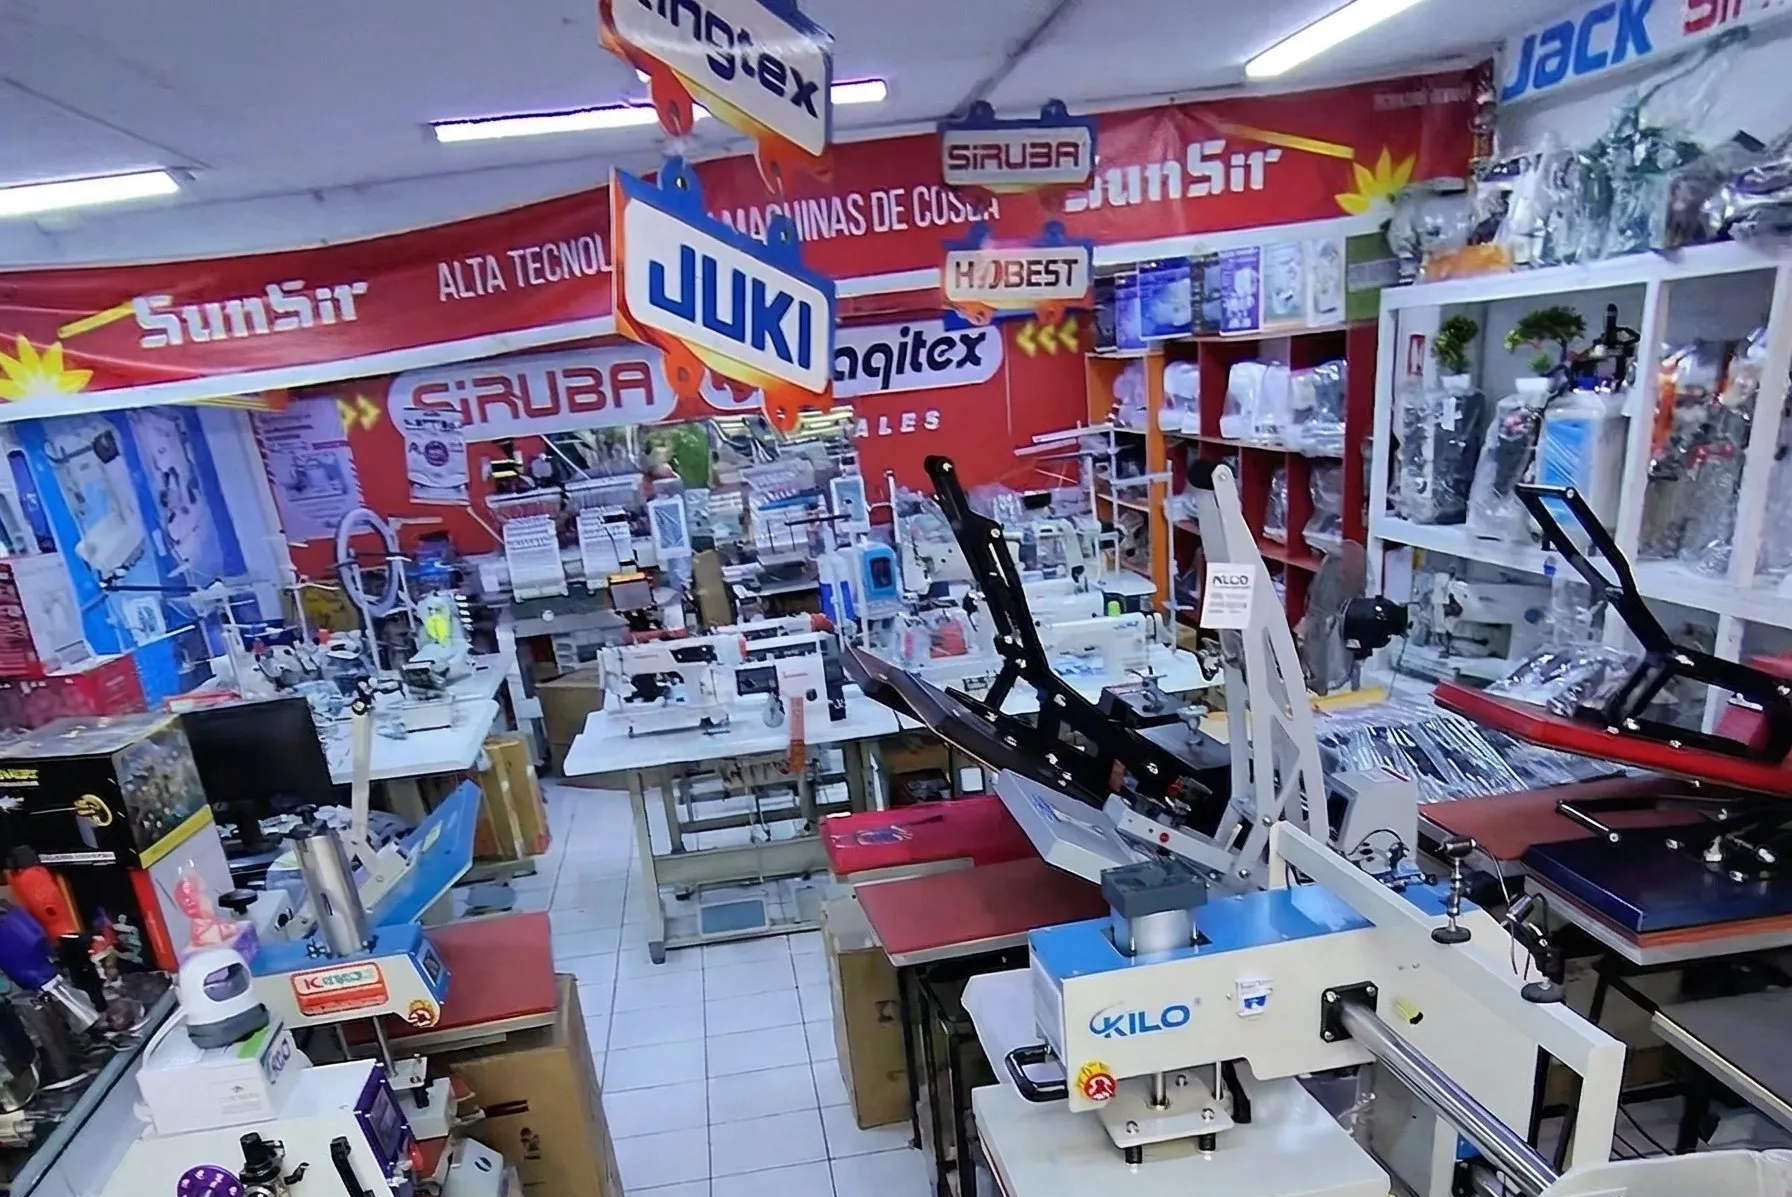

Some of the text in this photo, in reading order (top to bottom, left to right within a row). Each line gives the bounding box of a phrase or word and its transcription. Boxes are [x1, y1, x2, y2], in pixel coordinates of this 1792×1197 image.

[870, 188, 909, 232] DE
[438, 231, 615, 301] ALTA TECNOL
[133, 278, 369, 348] SunSir
[648, 243, 812, 371] JUKI
[832, 325, 987, 391] aqitex
[1091, 1003, 1191, 1039] KILO
